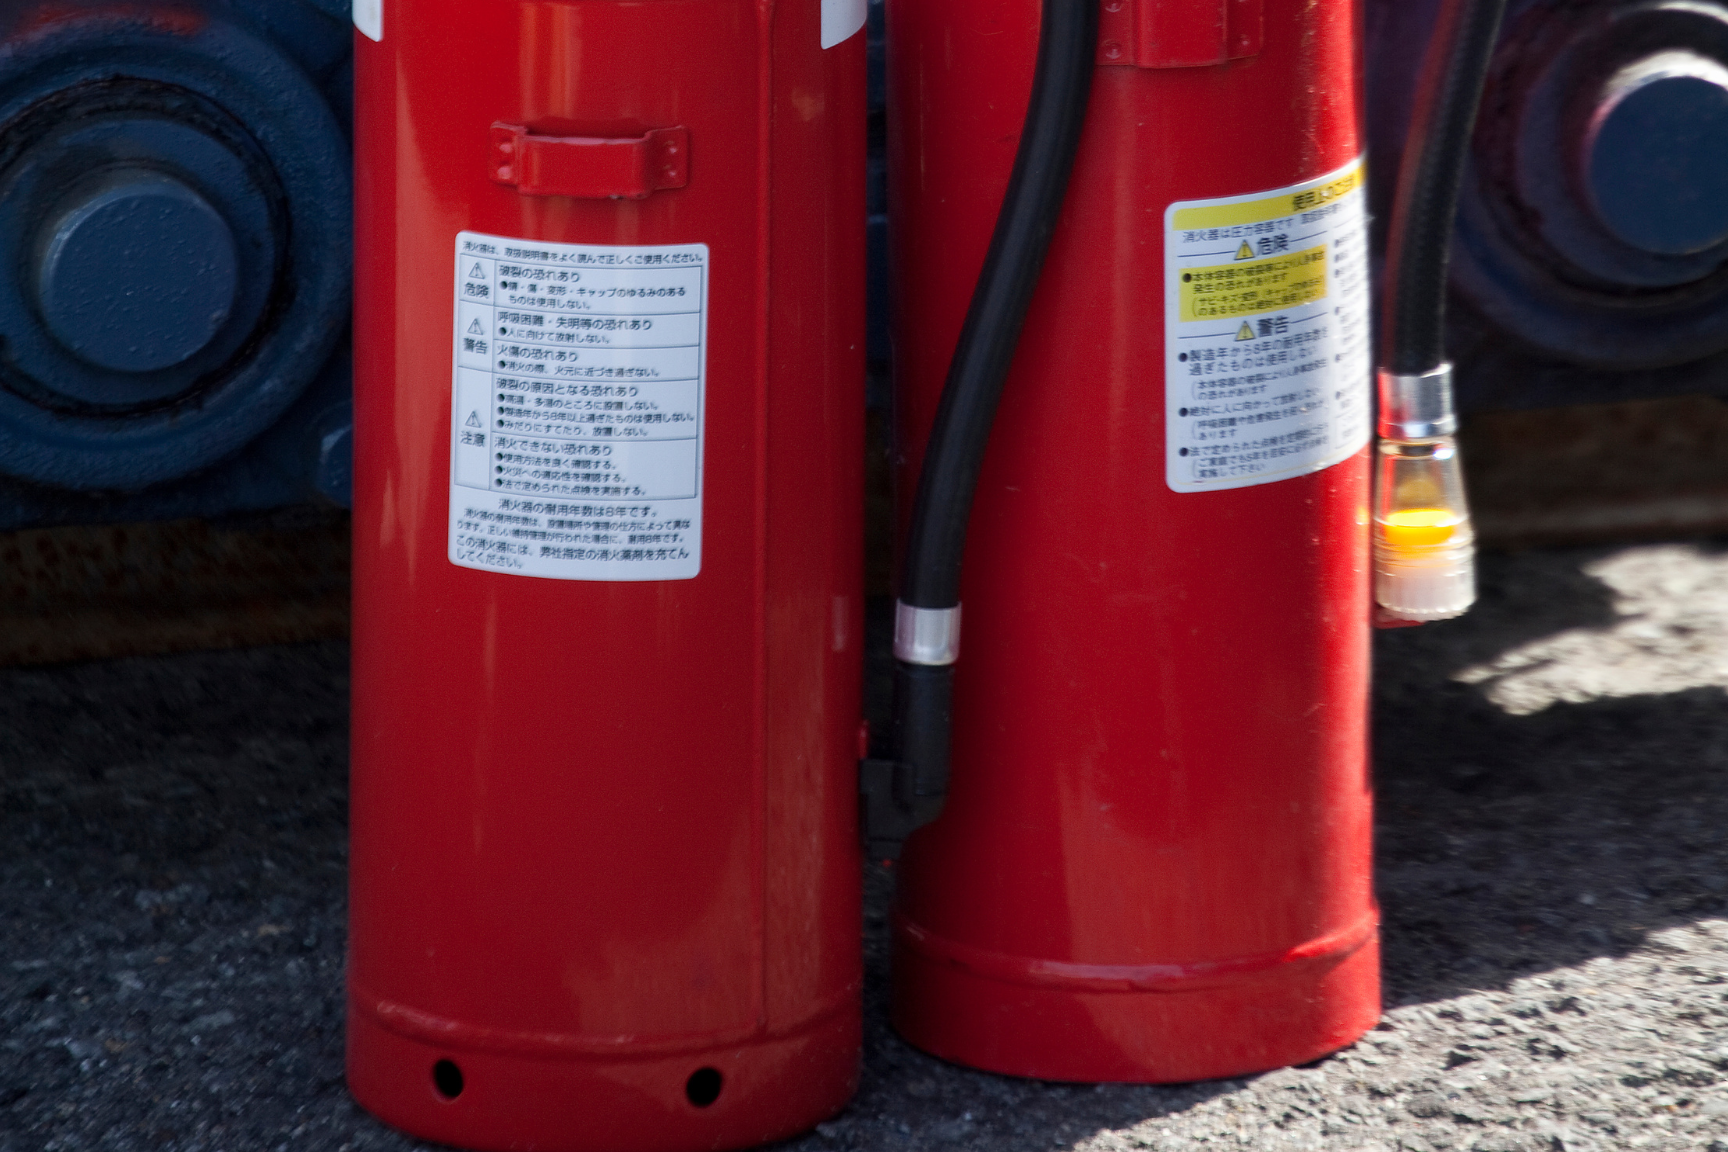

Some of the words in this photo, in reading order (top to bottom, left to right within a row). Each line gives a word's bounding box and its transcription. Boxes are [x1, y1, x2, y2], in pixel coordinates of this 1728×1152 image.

[1257, 234, 1289, 255] 危険
[499, 264, 580, 283] 破裂の恐れあり
[463, 282, 489, 299] 危険
[508, 295, 591, 310] ものは使用しない。
[497, 311, 652, 331] 呼吸困難・失明等の恐れあり
[1257, 315, 1289, 337] 警告
[506, 327, 610, 344] 人に向けて放射しない。
[463, 337, 488, 355] 警告
[497, 345, 578, 362] 火傷の恐れあり
[496, 377, 638, 397] 破裂の原因となる恐れあり
[460, 430, 485, 448] 注意
[494, 436, 612, 456] 消火できない恐れあり
[498, 498, 657, 518] 消火器の耐用年数は8年です。
[457, 549, 523, 569] してください。
